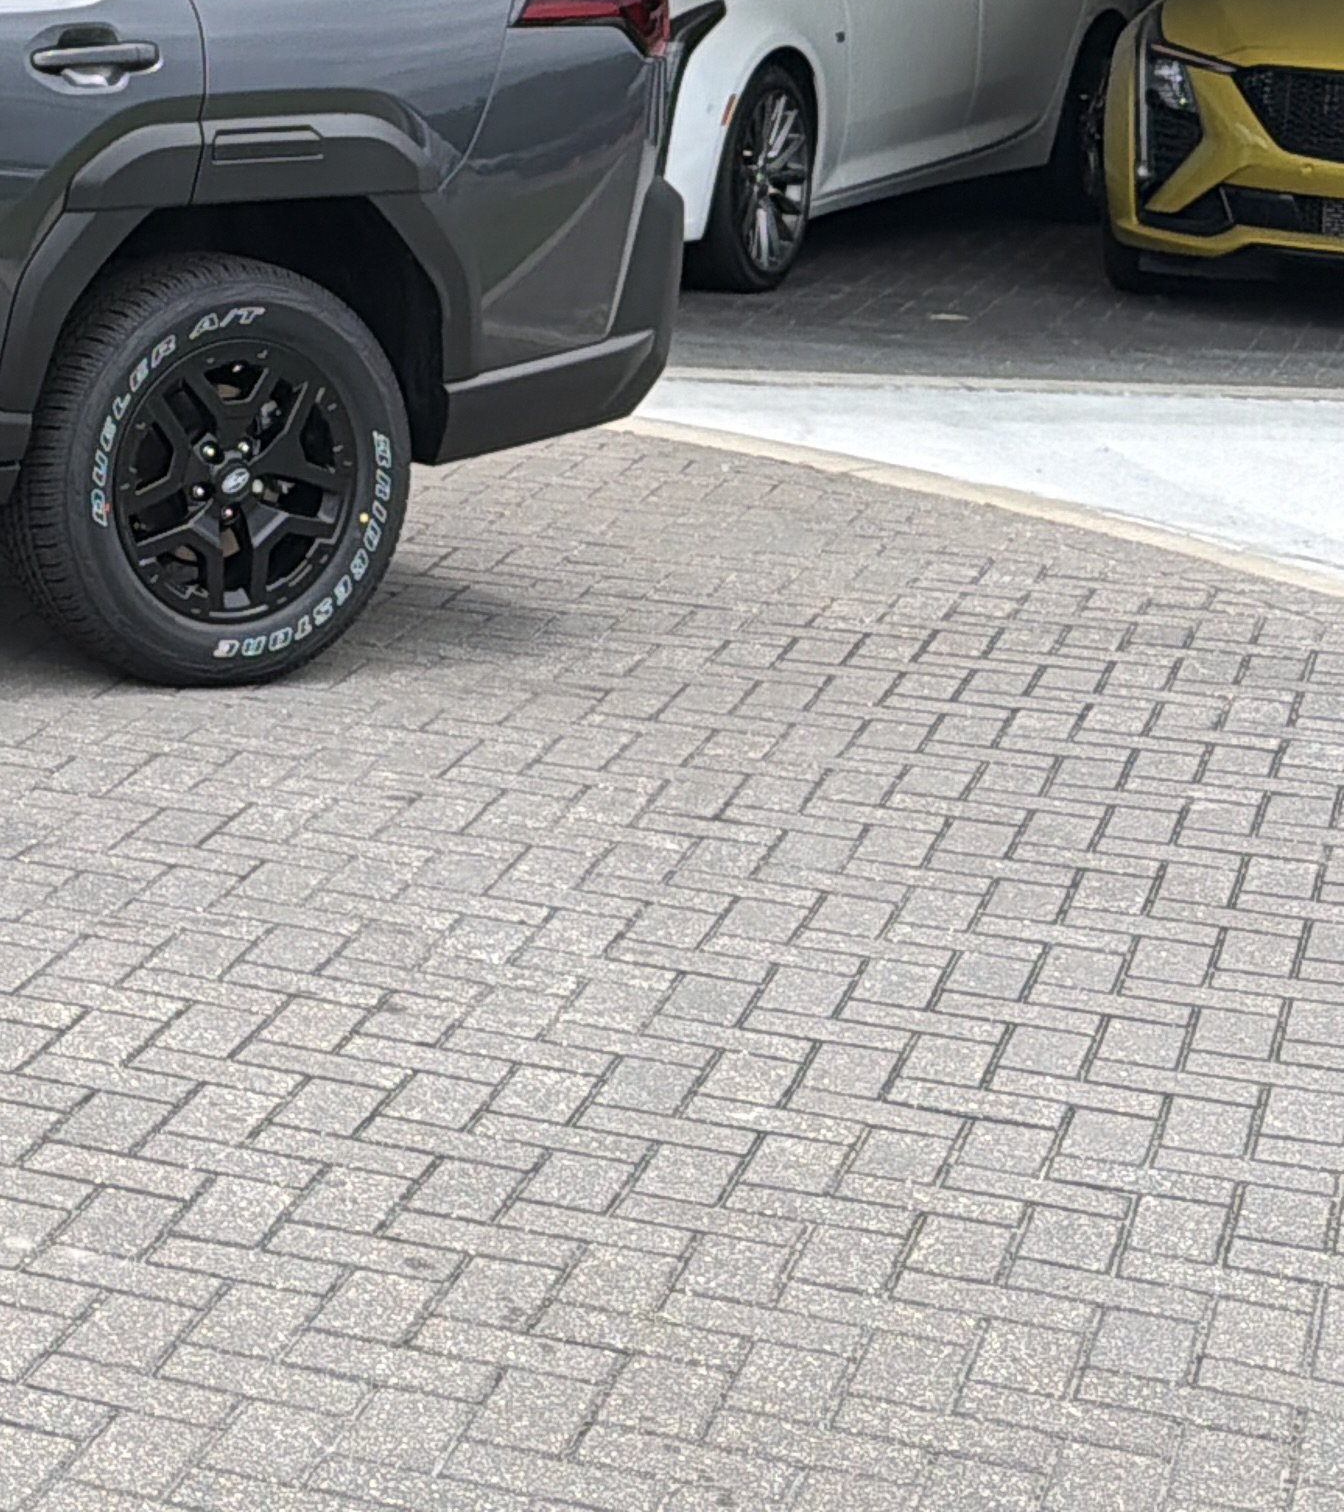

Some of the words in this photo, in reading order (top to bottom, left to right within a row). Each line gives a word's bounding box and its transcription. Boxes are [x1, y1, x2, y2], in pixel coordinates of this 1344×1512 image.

[90, 335, 176, 527] DUELER
[189, 307, 264, 340] A/T
[214, 430, 391, 657] BRIDGESTONE
